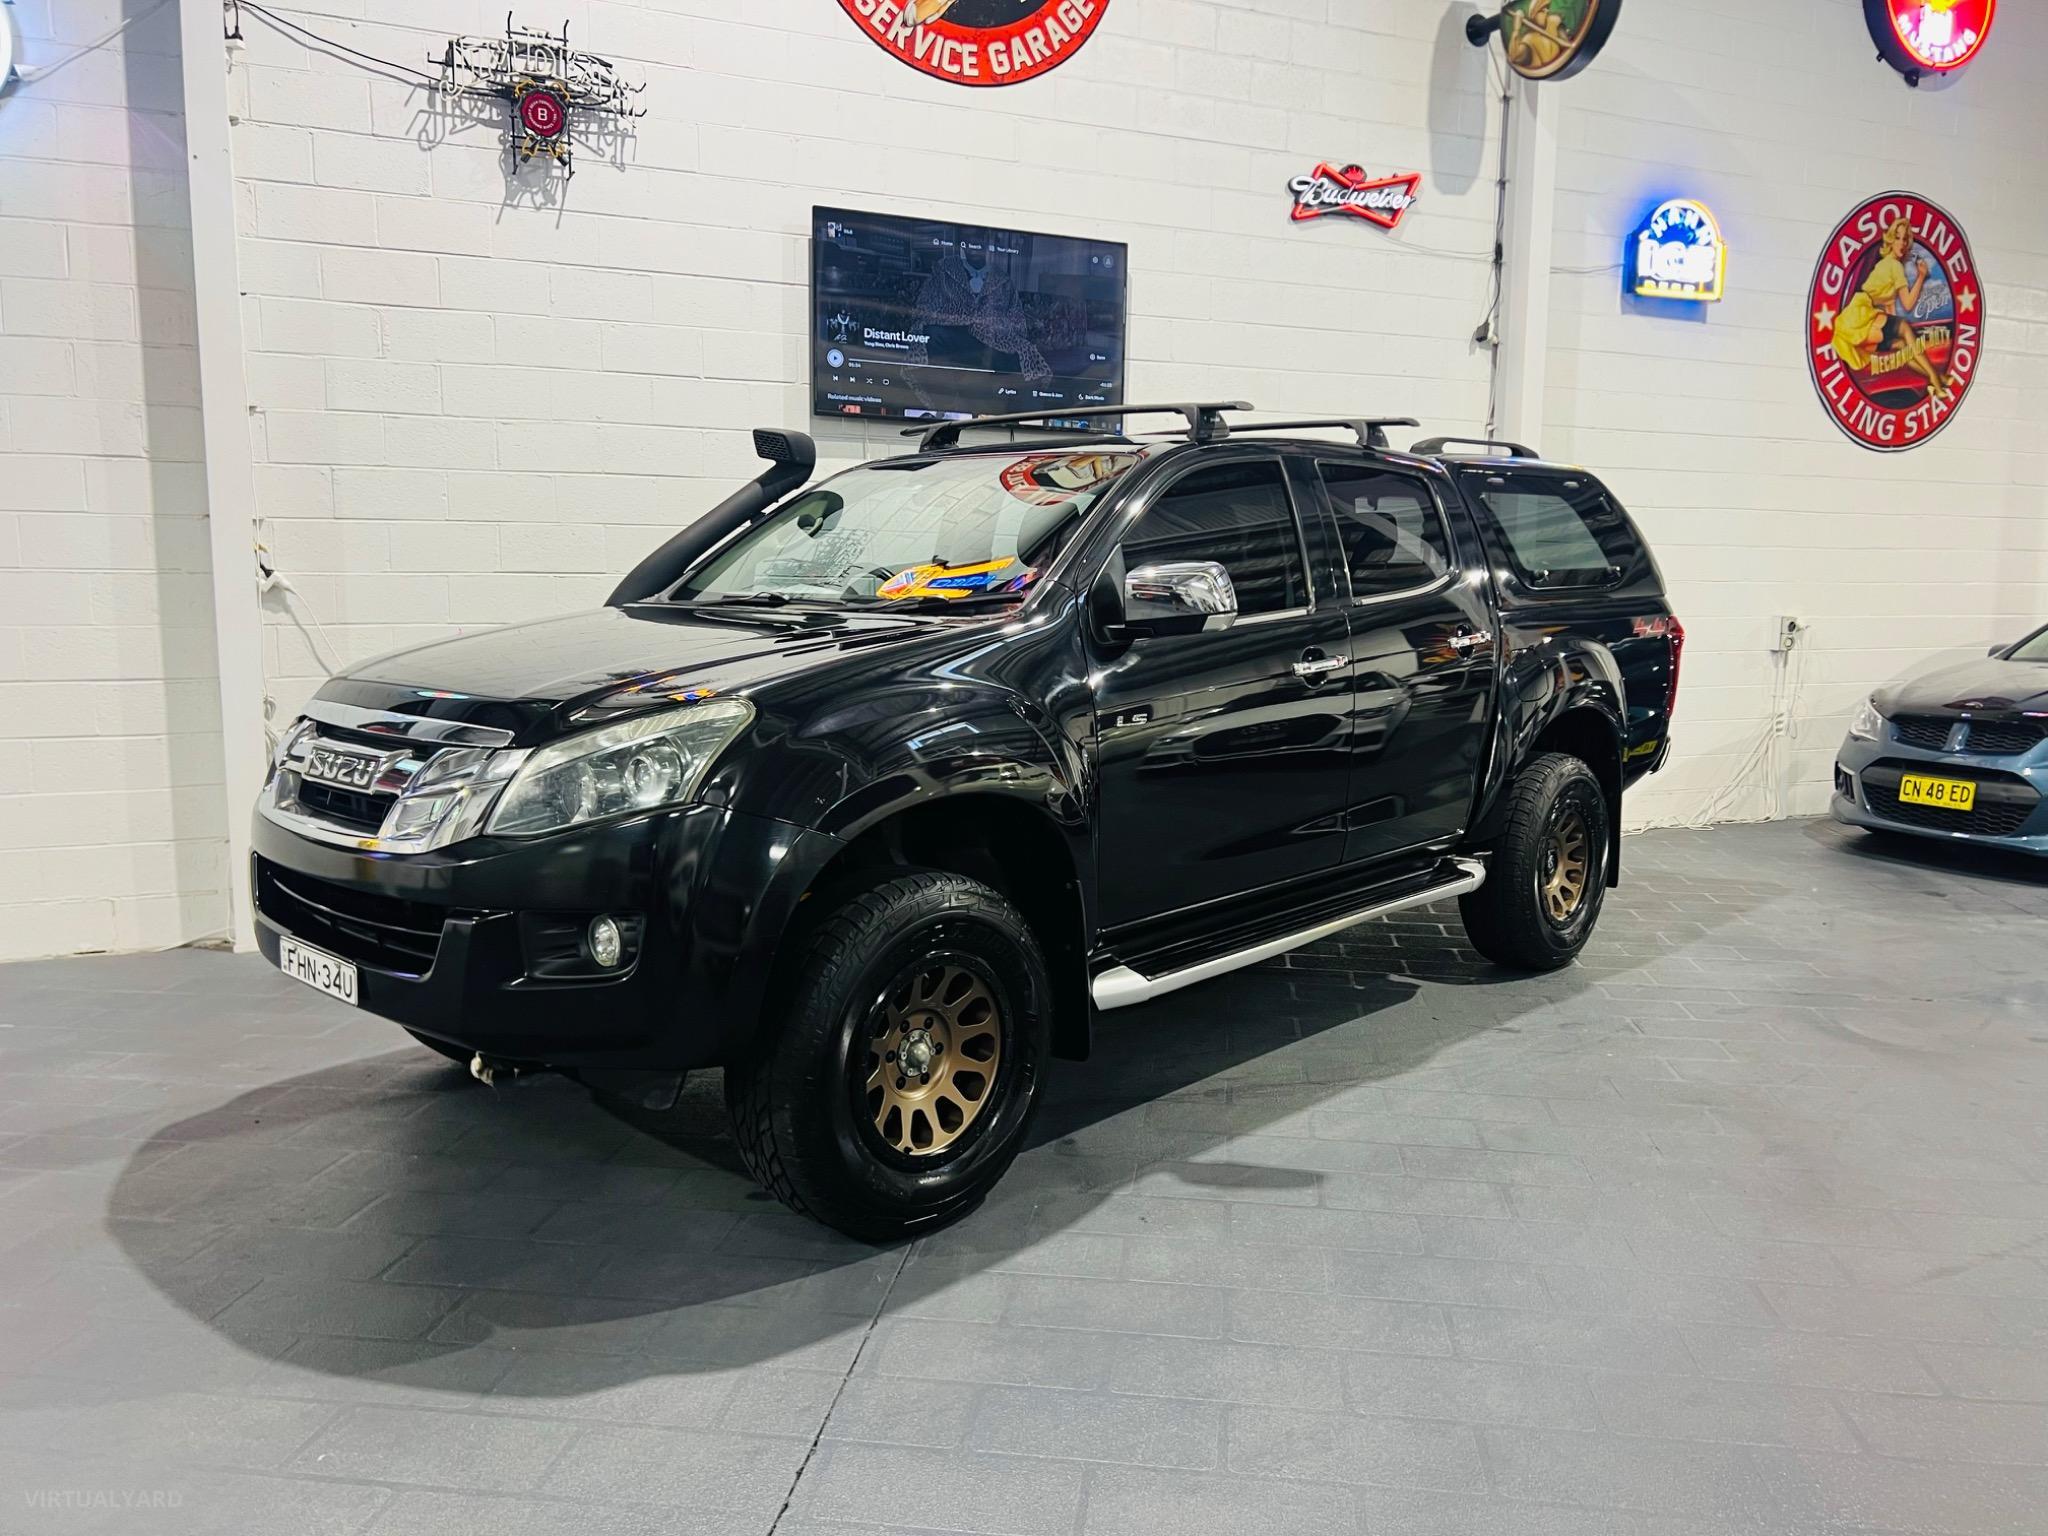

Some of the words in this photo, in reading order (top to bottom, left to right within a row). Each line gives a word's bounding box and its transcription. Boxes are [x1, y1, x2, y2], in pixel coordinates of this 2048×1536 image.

[988, 0, 1096, 75] GARAGE
[1897, 13, 1977, 63] MUSTANG
[538, 108, 547, 121] B
[1290, 175, 1416, 209] Budweiser
[1821, 203, 1969, 295] GASOLINE
[864, 327, 901, 341] Distant
[901, 331, 930, 343] Lover
[1816, 343, 1897, 440] FILLING
[1117, 713, 1148, 728] LS
[1903, 779, 1922, 797] CN
[1926, 782, 1945, 800] 48
[1949, 785, 1971, 803] ED
